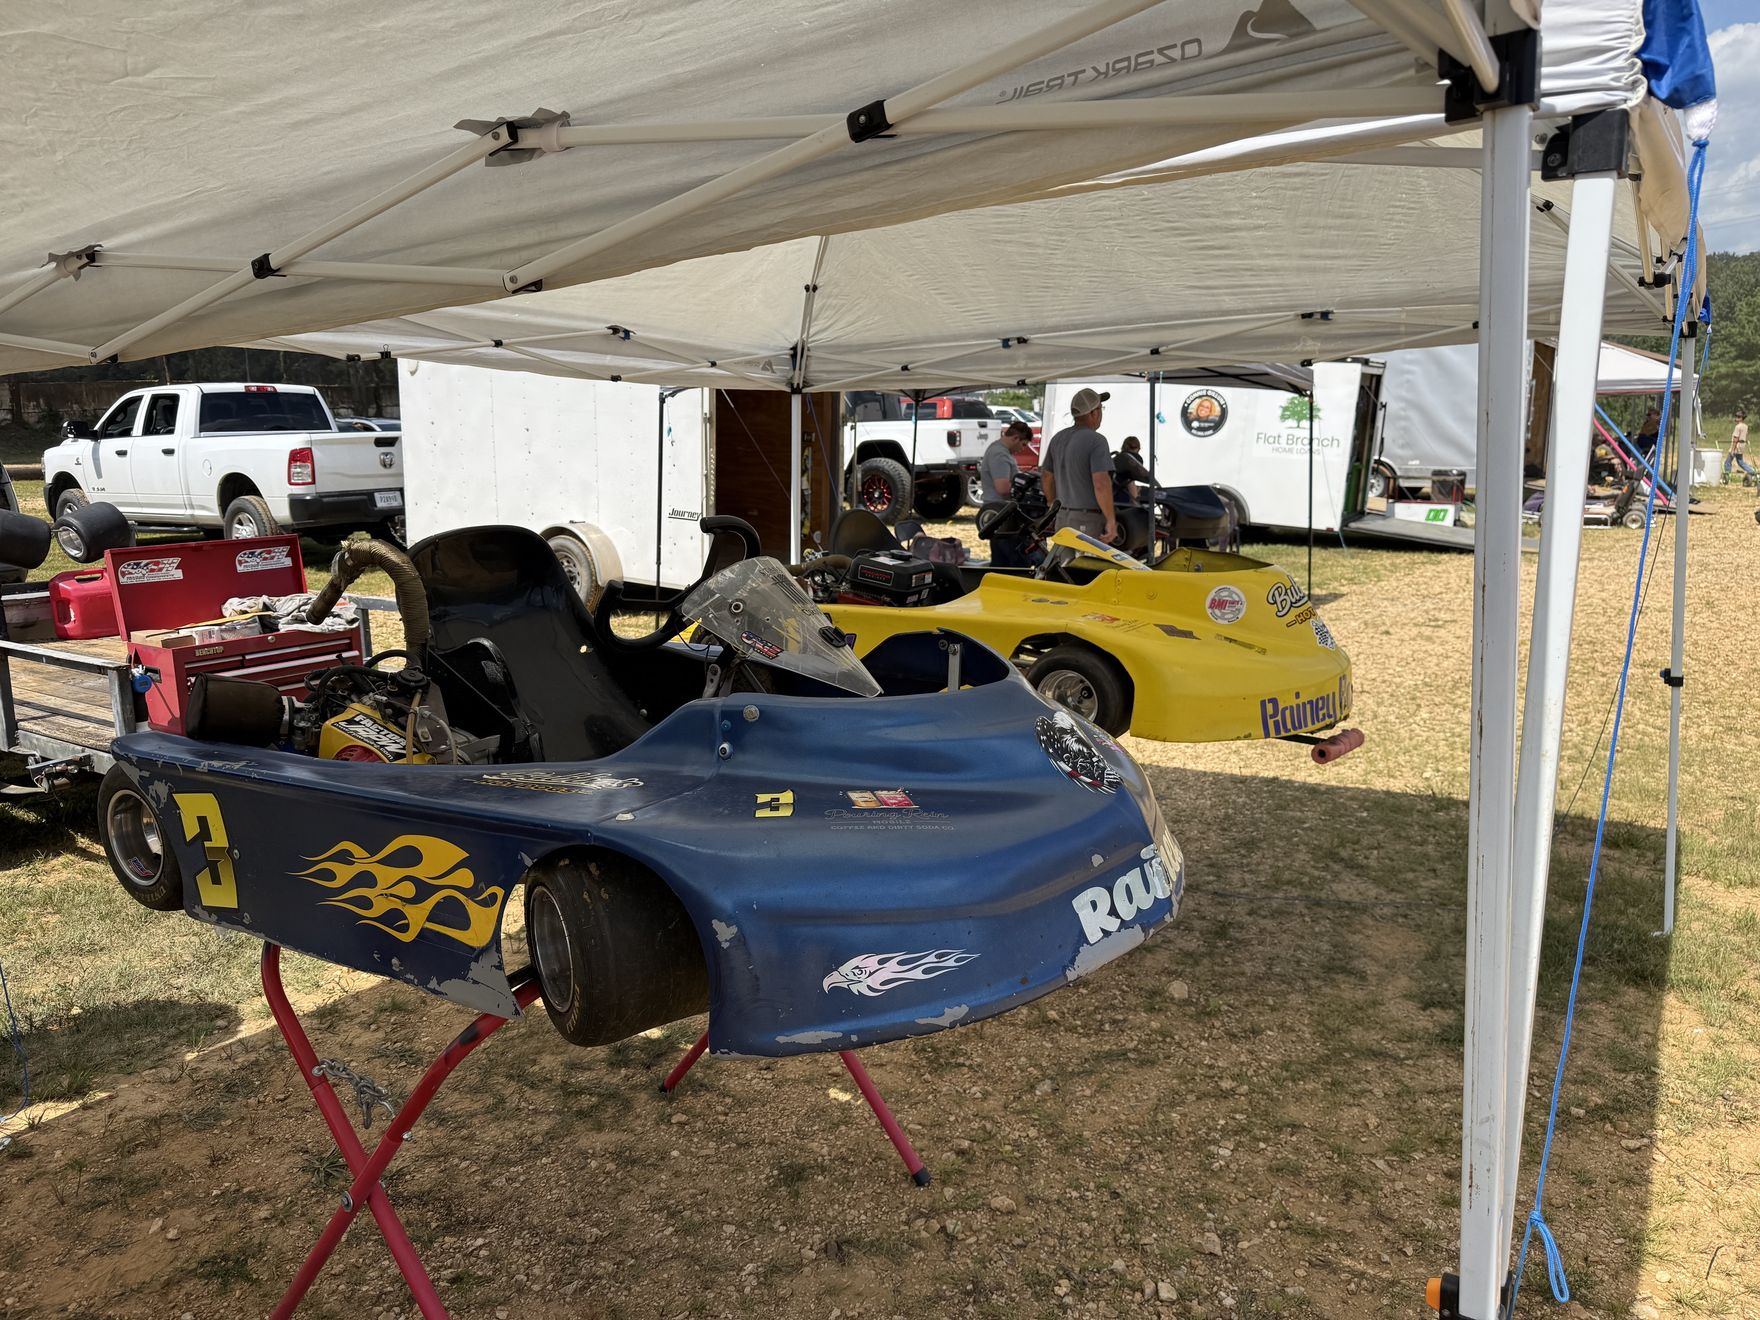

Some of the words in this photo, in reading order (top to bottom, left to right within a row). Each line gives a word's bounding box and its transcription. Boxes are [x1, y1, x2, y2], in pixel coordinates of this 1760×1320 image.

[1255, 432, 1282, 445] Flat
[1285, 433, 1340, 448] Branch
[1271, 446, 1295, 454] HOME
[668, 508, 704, 521] Journey
[1208, 597, 1229, 610] BMI
[1294, 606, 1317, 625] HOT
[1260, 691, 1337, 739] Rainey
[354, 714, 418, 752] FACTOR
[755, 789, 796, 818] 3
[172, 793, 238, 909] 3
